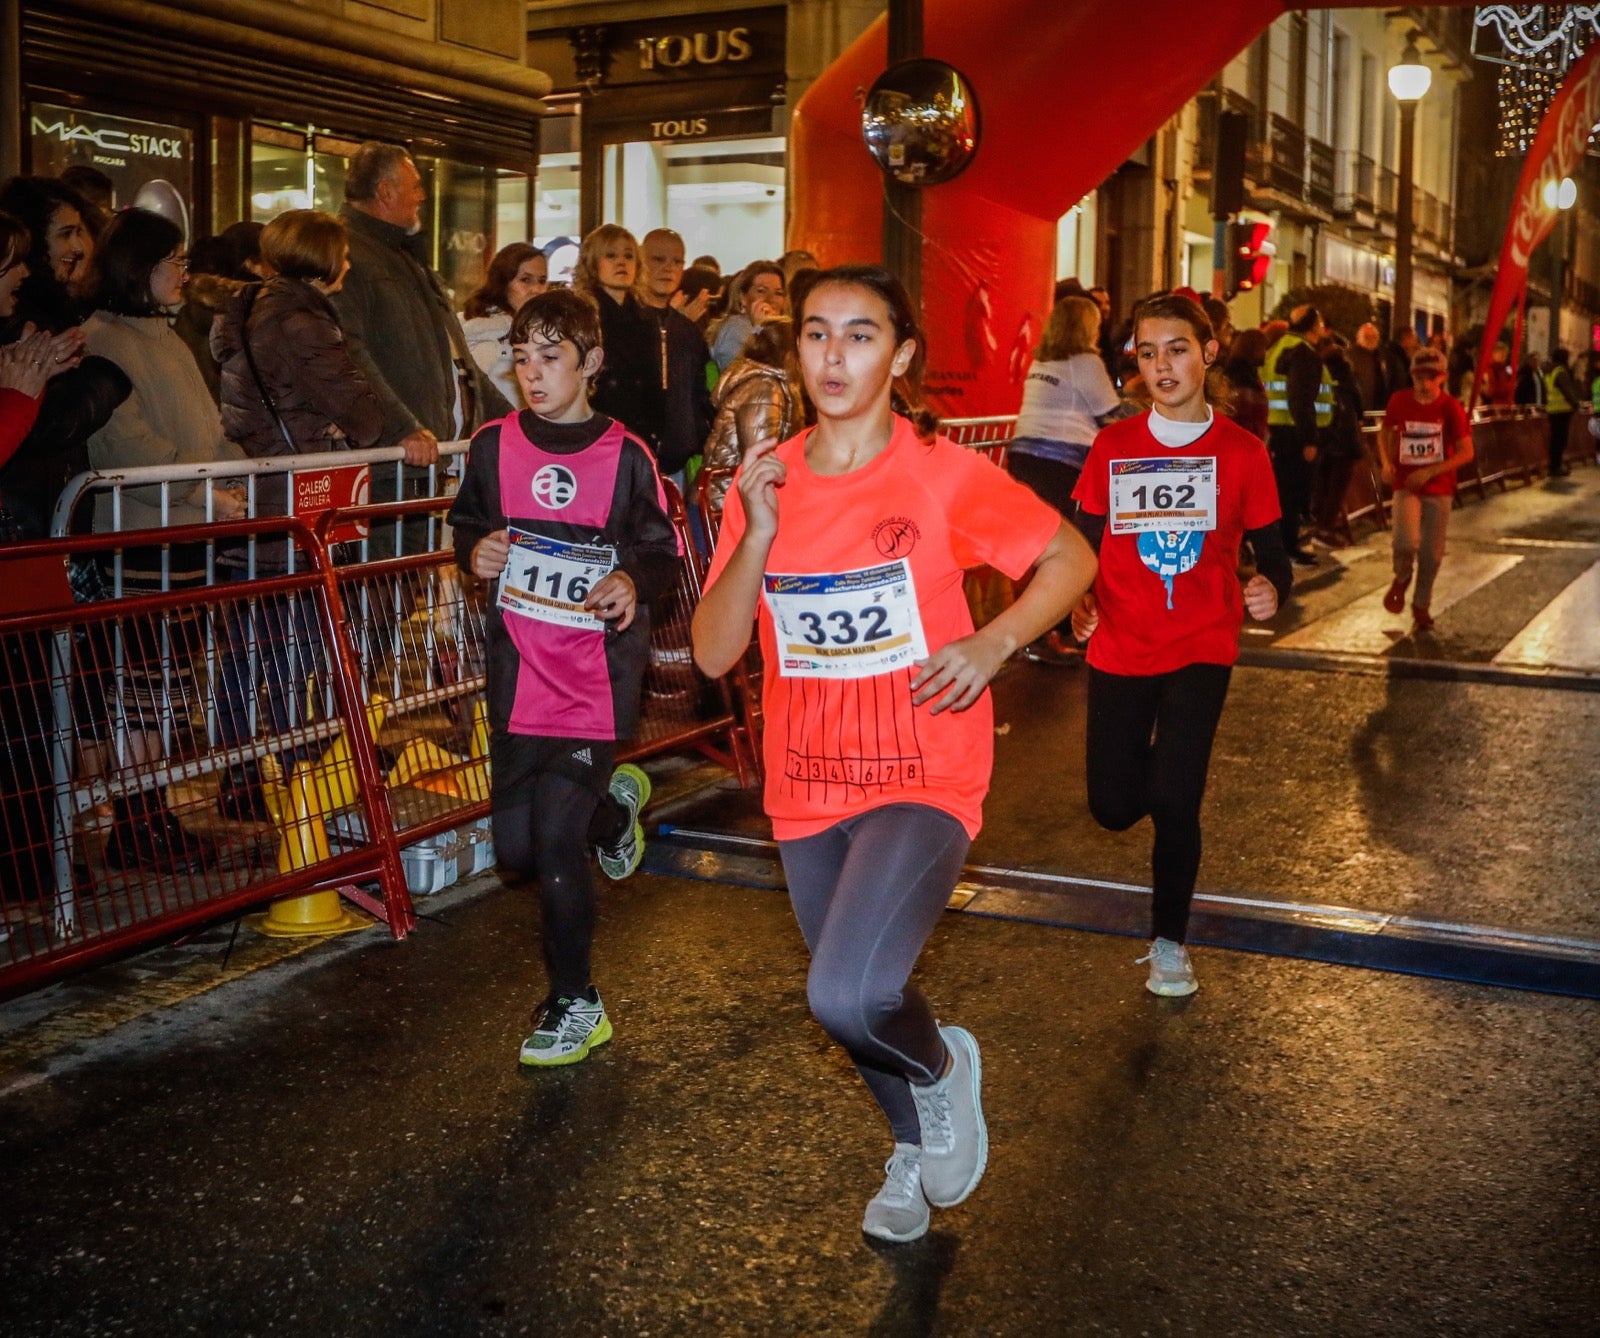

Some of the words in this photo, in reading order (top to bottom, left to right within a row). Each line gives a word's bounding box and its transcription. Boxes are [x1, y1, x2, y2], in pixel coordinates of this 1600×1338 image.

[637, 27, 752, 69] TOUS
[651, 118, 708, 137] TOUS
[130, 134, 182, 159] STACK
[299, 475, 331, 496] CALERO
[1132, 485, 1196, 511] 162
[299, 494, 331, 508] AGUILERA
[523, 565, 590, 603] 116
[798, 605, 893, 646] 332
[795, 761, 802, 777] 2
[812, 762, 820, 778] 3
[831, 766, 838, 780] 4
[866, 766, 873, 782] 6
[887, 766, 894, 780] 7
[907, 764, 915, 778] 8
